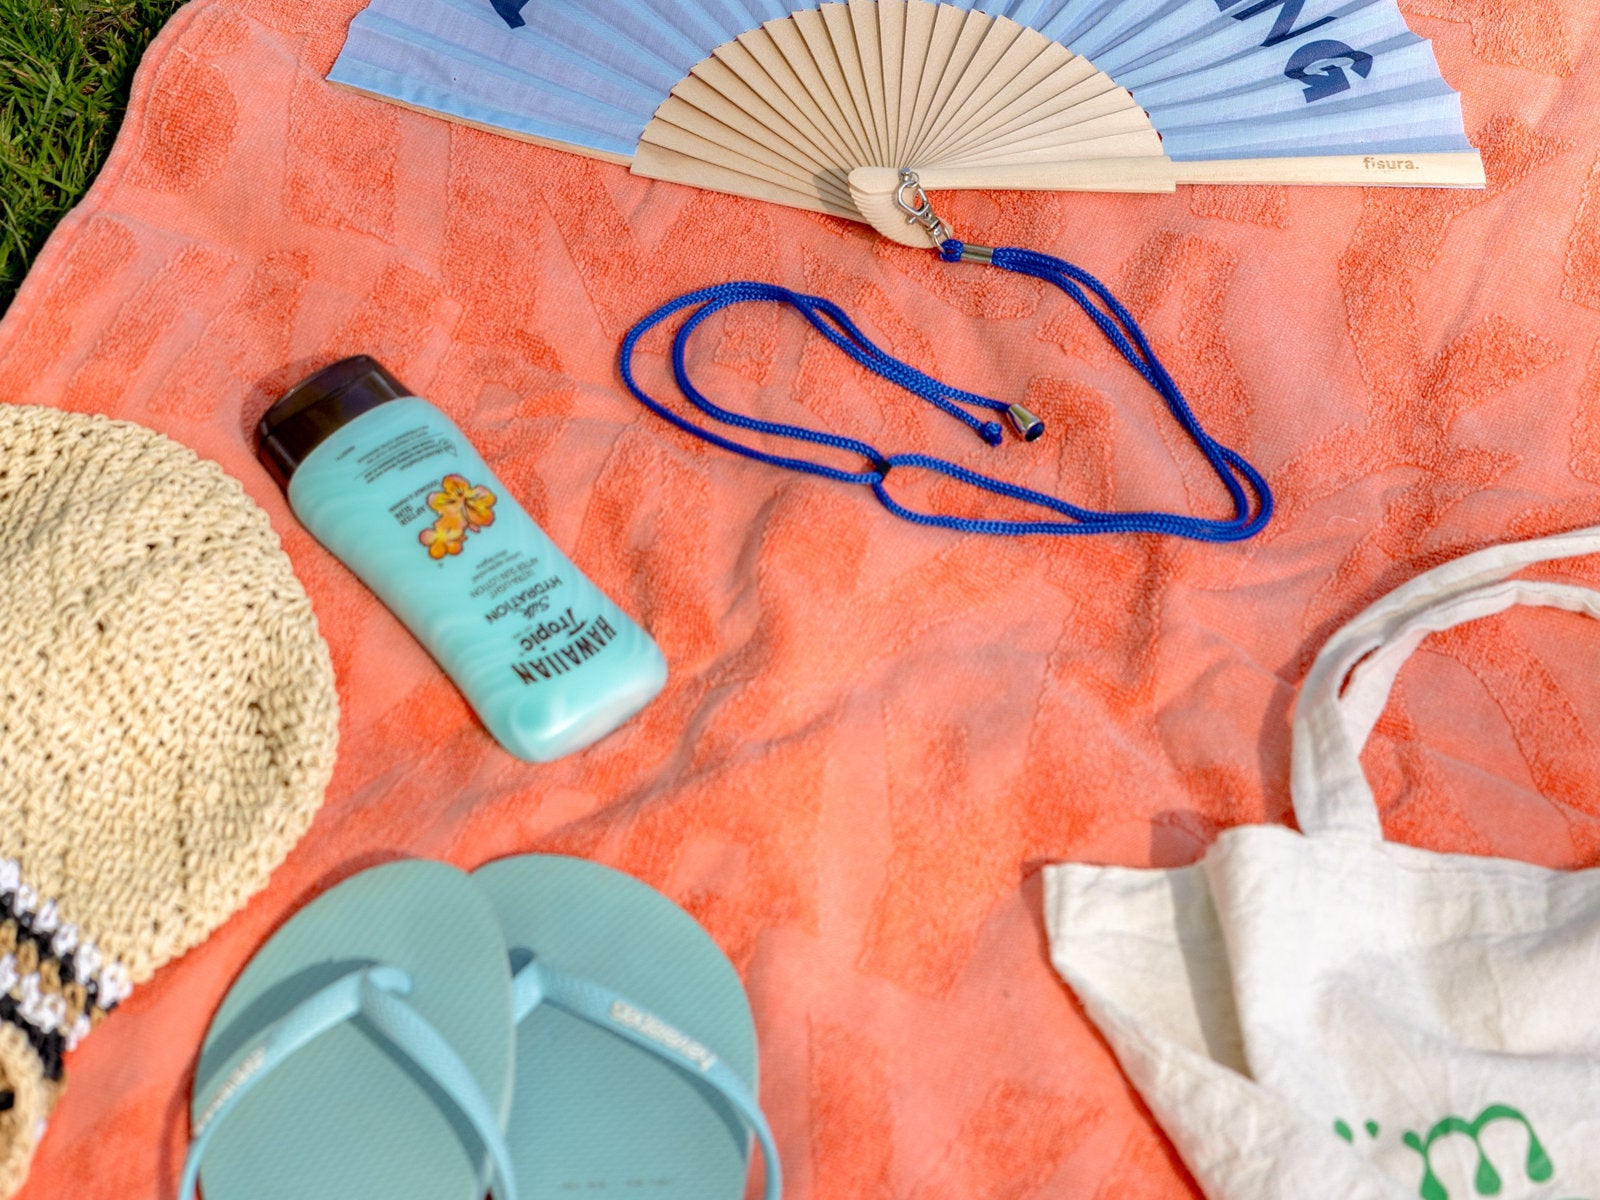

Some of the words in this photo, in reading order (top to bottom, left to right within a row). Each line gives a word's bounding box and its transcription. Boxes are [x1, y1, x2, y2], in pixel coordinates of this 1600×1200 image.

[1364, 157, 1419, 170] fisura.
[486, 576, 562, 622] HYDRATION
[511, 616, 616, 685] HAWAIIAN
[520, 608, 587, 651] Tropic
